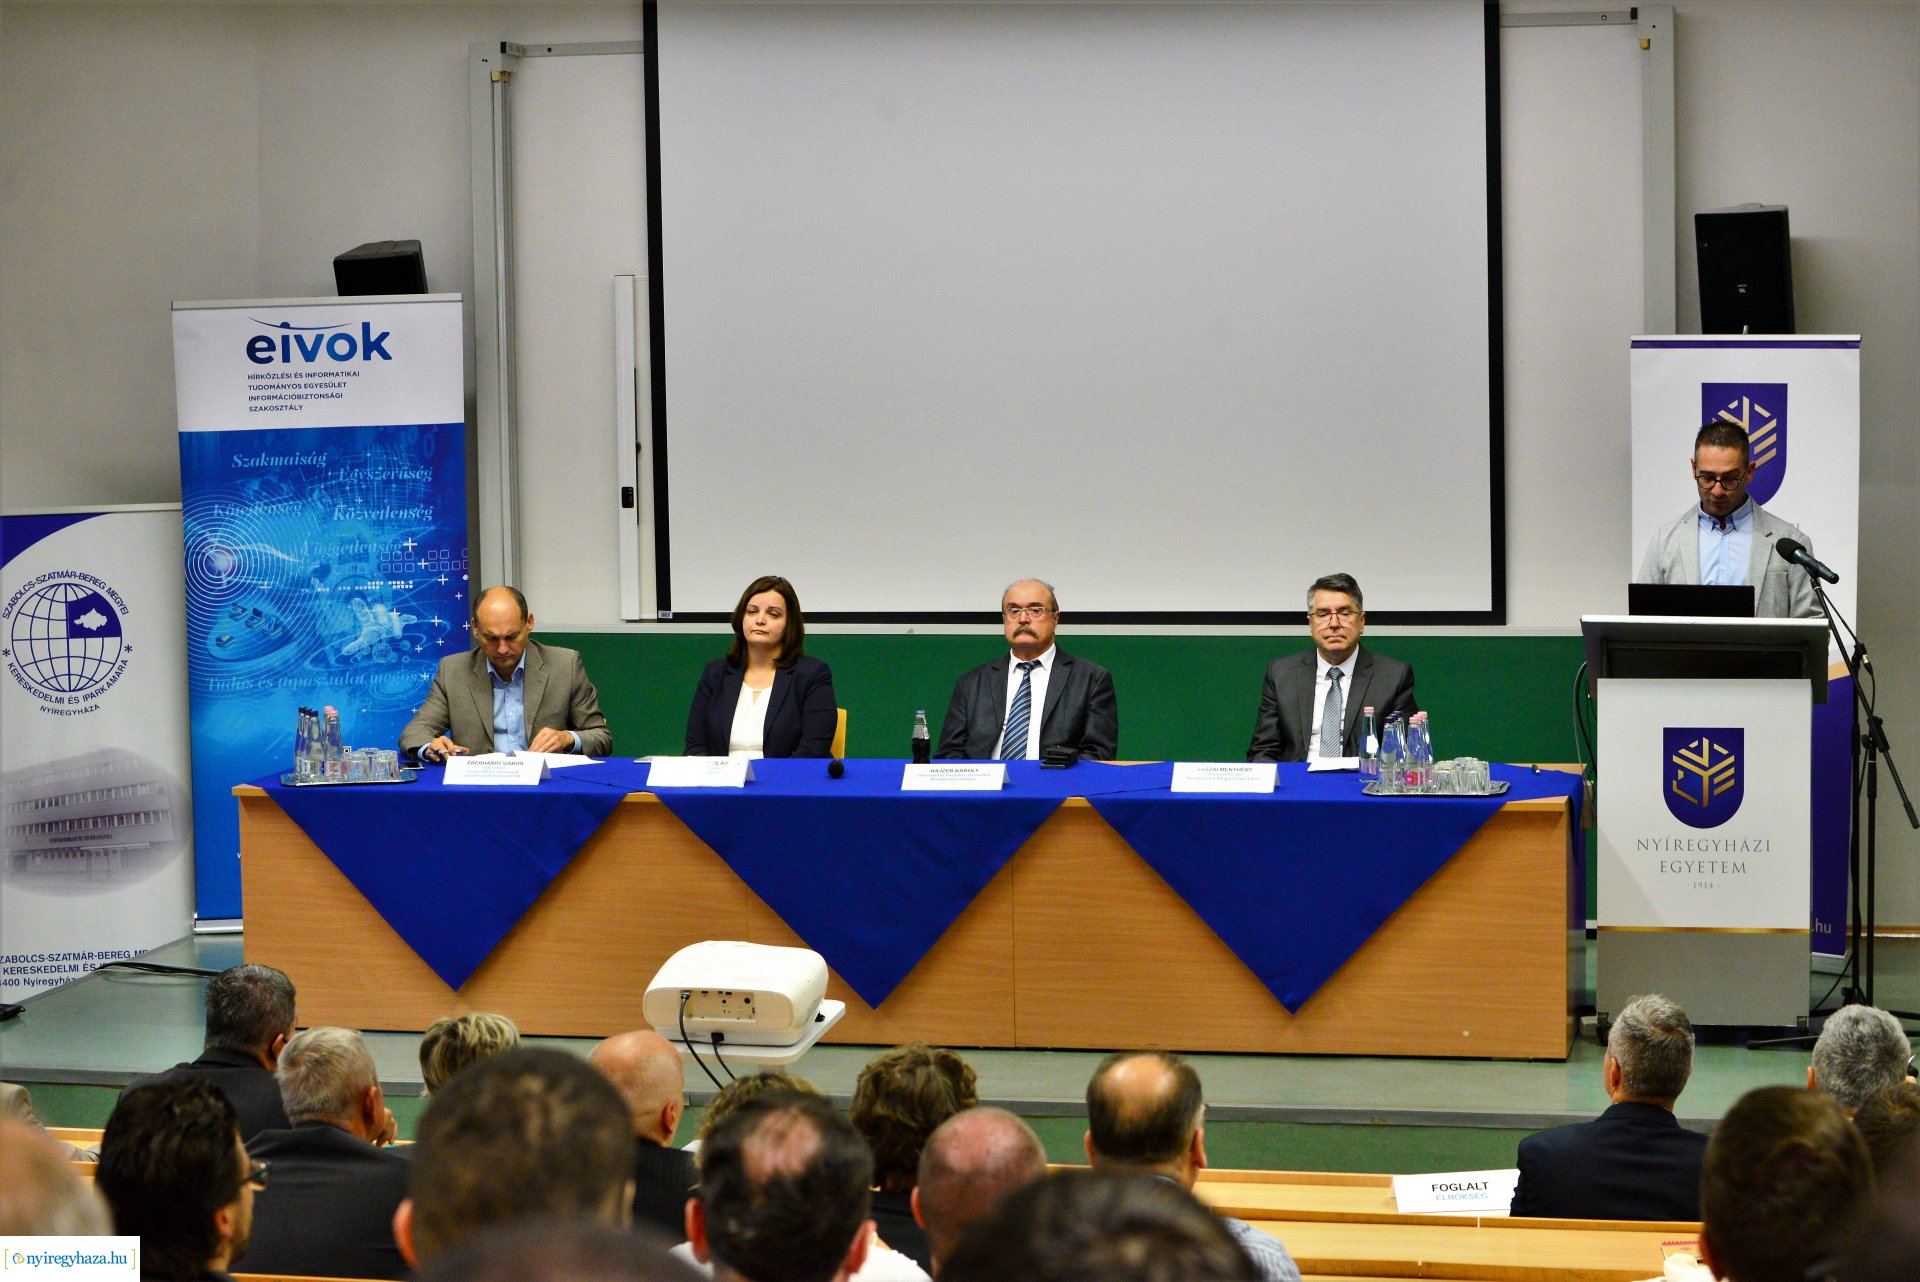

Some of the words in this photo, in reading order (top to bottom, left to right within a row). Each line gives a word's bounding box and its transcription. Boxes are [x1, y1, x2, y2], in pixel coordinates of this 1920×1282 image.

[246, 321, 392, 364] eivok
[294, 371, 303, 379] ÉS
[304, 381, 347, 389] EGYESÜLET
[248, 393, 343, 401] INFORMÁCIÓBIZTONSÁGI
[249, 404, 303, 412] SZAKOSZTÁLY
[231, 451, 327, 468] Szakmaiság
[333, 504, 433, 521] Közvetlenség
[3, 569, 107, 619] SZABOLCS-SZATMÁR-BEREG
[106, 587, 129, 615] MEGYEI
[7, 662, 65, 705] KERESKEDELMI
[68, 697, 80, 705] ÉS
[82, 658, 128, 703] IPARKAMARA
[40, 704, 100, 716] NYÍREGYHÁZA
[1637, 837, 1771, 853] NYÍREGYHÁZI
[1660, 861, 1746, 874] EGYETEM
[3, 964, 79, 975] KERESKEDELMI
[82, 962, 96, 972] ÉS
[0, 978, 20, 986] 400
[1431, 1181, 1489, 1193] FOGLALT
[1435, 1192, 1489, 1201] ELNÖKSÉG
